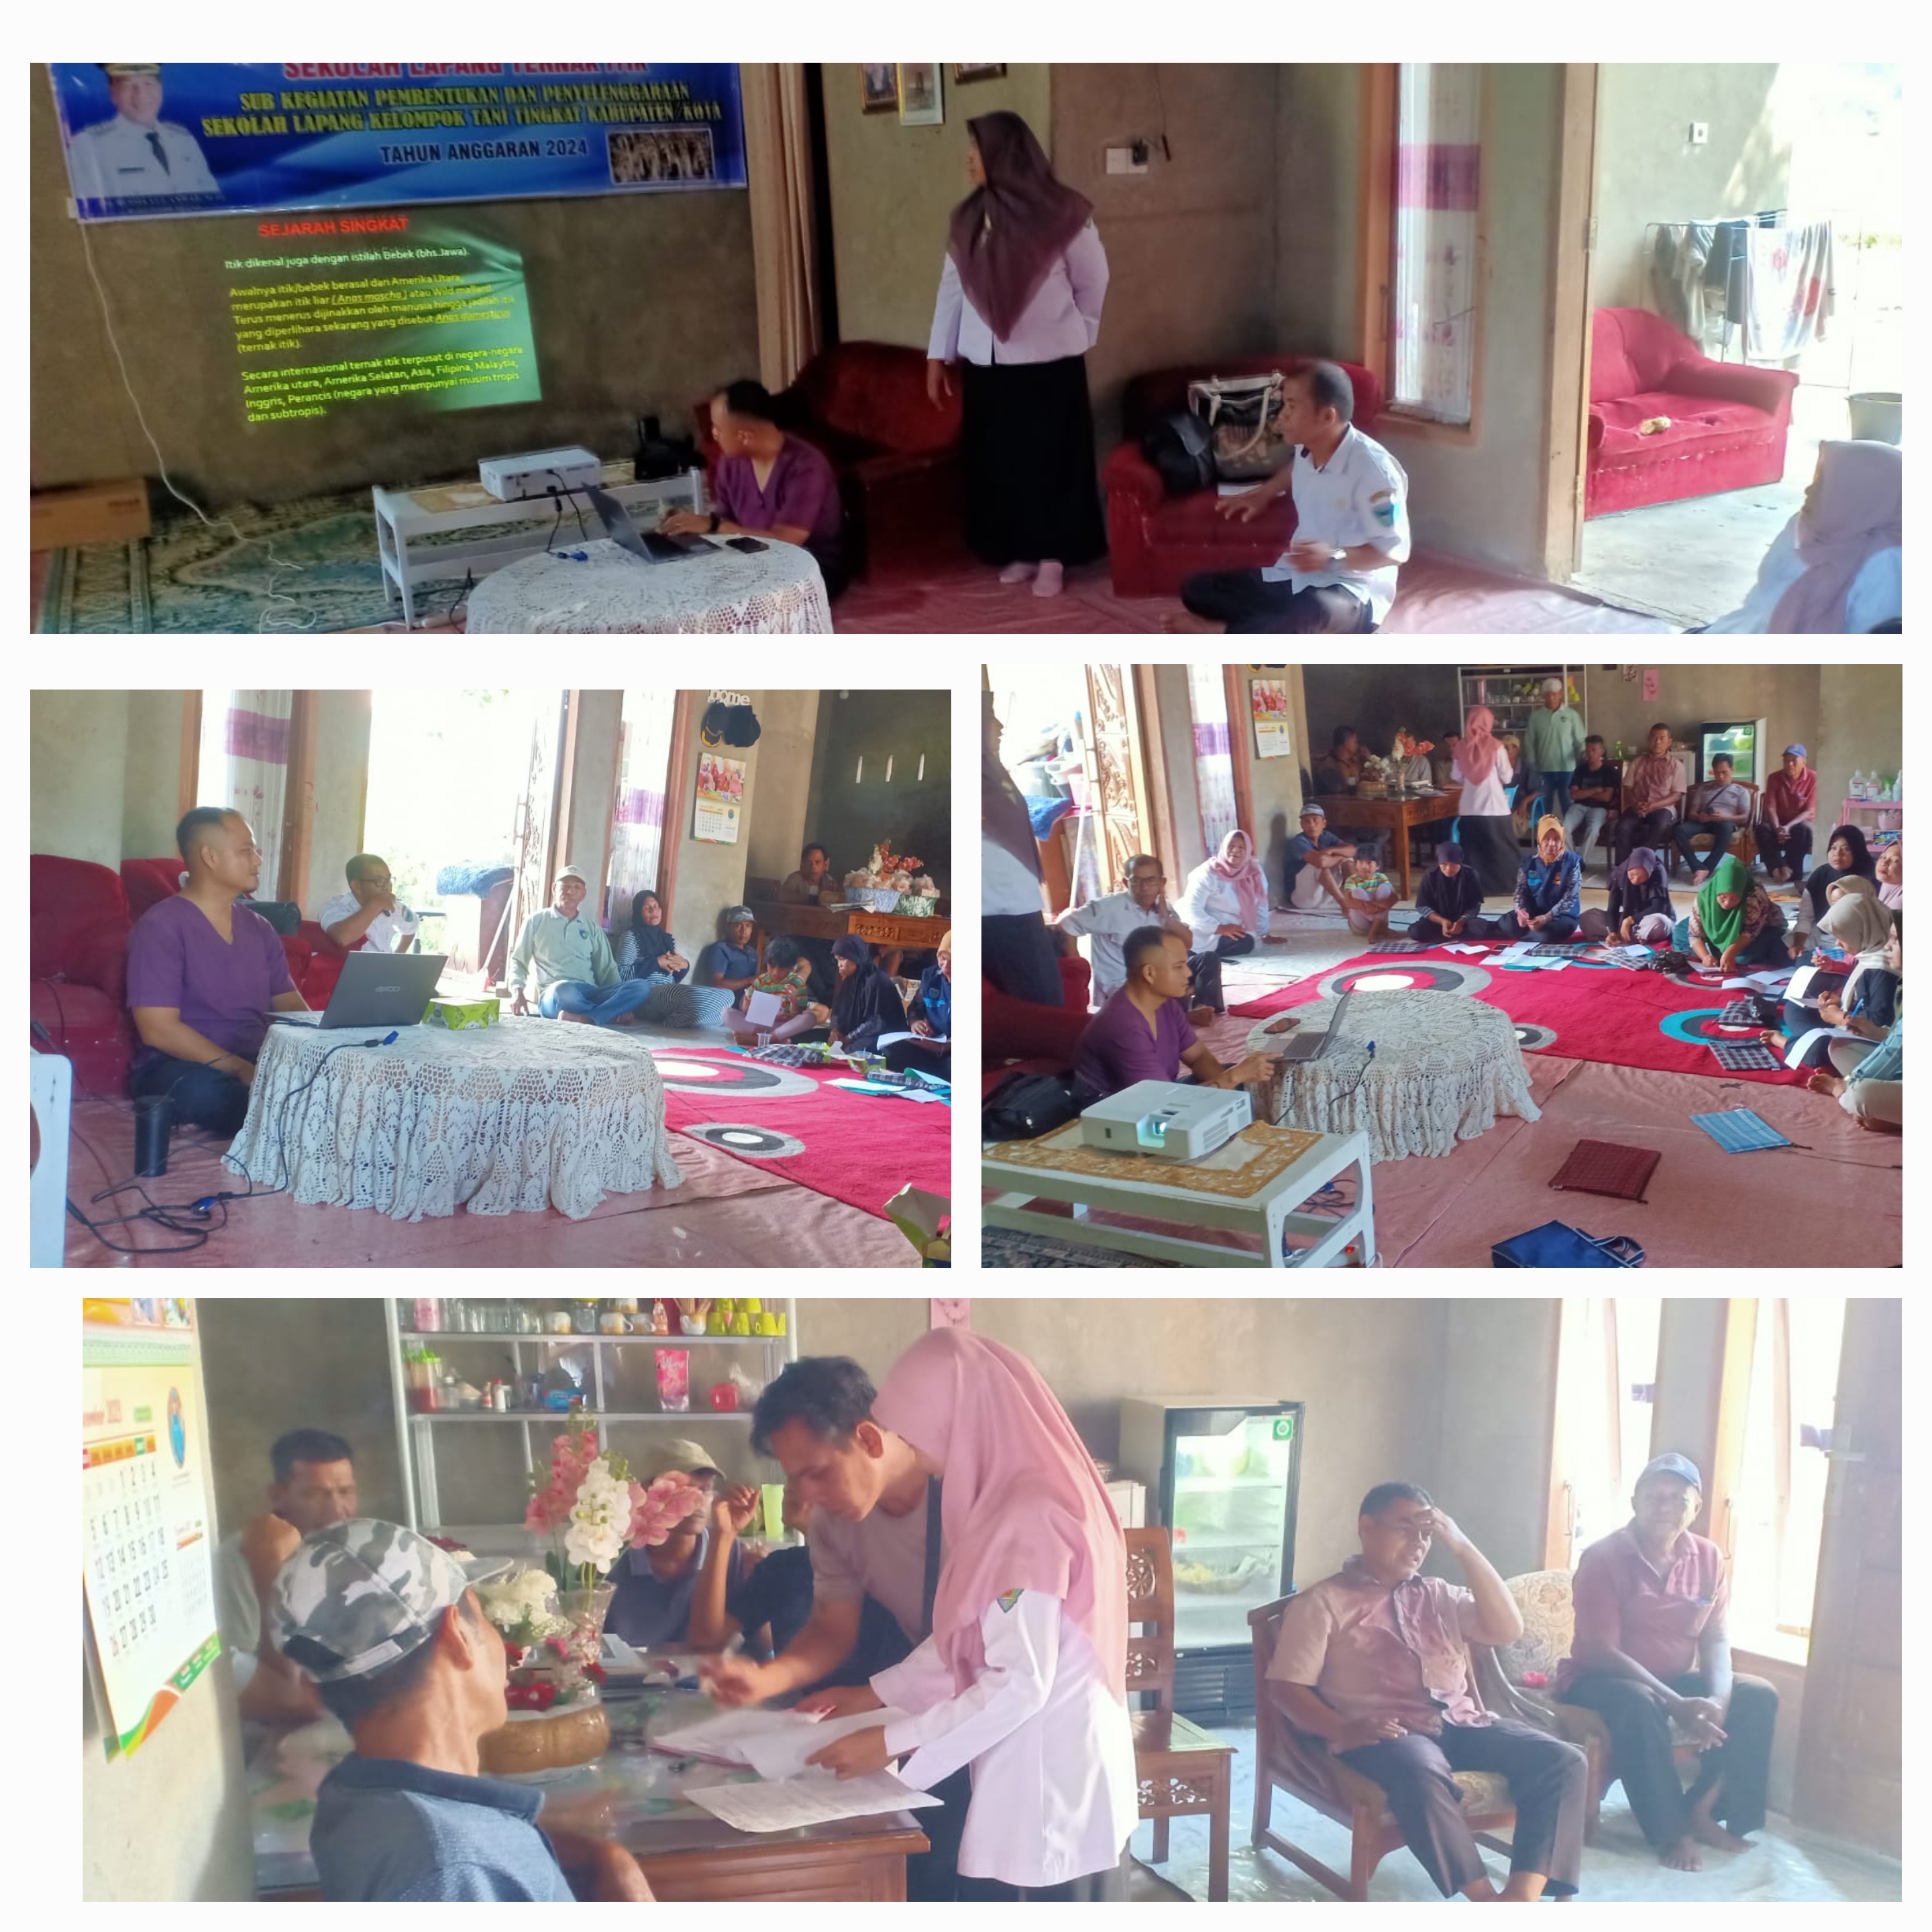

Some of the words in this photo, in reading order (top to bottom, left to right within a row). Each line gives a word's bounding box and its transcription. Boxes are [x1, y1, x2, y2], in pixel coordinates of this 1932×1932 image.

[239, 93, 275, 111] SUB
[280, 90, 369, 109] KEGIATAN
[375, 87, 498, 106] PEMBENTUKAN
[504, 86, 537, 103] DAN
[542, 81, 690, 102] PENYELENGGARAAN
[202, 115, 288, 138] SEKOLAH
[292, 113, 364, 133] LAPANG
[369, 110, 466, 129] KELOMPOK
[472, 108, 508, 126] TANI
[515, 105, 582, 124] TINGKAT
[381, 144, 441, 163] TAHUN
[447, 141, 539, 160] ANGGARAN
[545, 139, 588, 156] 2024
[259, 222, 336, 236] SEJARAH
[339, 217, 408, 233] SINGKAT
[245, 258, 284, 268] dikenal
[286, 258, 309, 268] juga
[311, 254, 350, 266] dengan
[351, 252, 382, 262] istilah
[383, 250, 415, 260] Bebek
[229, 287, 276, 298] Awalnya
[332, 280, 369, 290] berasal
[392, 276, 433, 286] Amerika
[231, 300, 293, 313] merupakan
[295, 298, 311, 307] itik
[313, 296, 330, 305] liar
[409, 290, 432, 299] atau
[433, 288, 454, 297] Wild
[233, 315, 263, 325] Terus
[266, 313, 312, 323] menerus
[313, 307, 366, 320] dijinakkan
[368, 305, 390, 315] oleh
[391, 303, 433, 312] manusia
[434, 301, 467, 310] hingga
[235, 330, 263, 341] yang
[265, 325, 321, 337] diperlihara
[323, 321, 370, 331] sekarang
[371, 318, 396, 329] yang
[398, 316, 433, 325] disebut
[237, 341, 277, 354] (ternak
[278, 339, 303, 350] itik).
[241, 371, 278, 381] Secara
[280, 362, 348, 377] internasional
[349, 360, 382, 369] ternak
[384, 357, 400, 366] itik
[402, 354, 443, 366] terpusat
[444, 352, 453, 360] di
[455, 347, 524, 361] negara-negara
[244, 384, 289, 394] Amerika
[292, 381, 323, 392] utara,
[325, 375, 368, 386] Amerika
[368, 371, 409, 381] Selatan,
[411, 368, 435, 377] Asia,
[437, 364, 474, 374] Filipina,
[475, 360, 519, 371] Malaysia,
[246, 398, 286, 410] Inggris,
[288, 393, 332, 404] Perancis
[333, 389, 372, 399] (negara
[374, 385, 399, 395] yang
[400, 378, 458, 392] mempunyai
[460, 376, 492, 385] musim
[248, 412, 268, 422] dan
[270, 406, 327, 419] subtropis).
